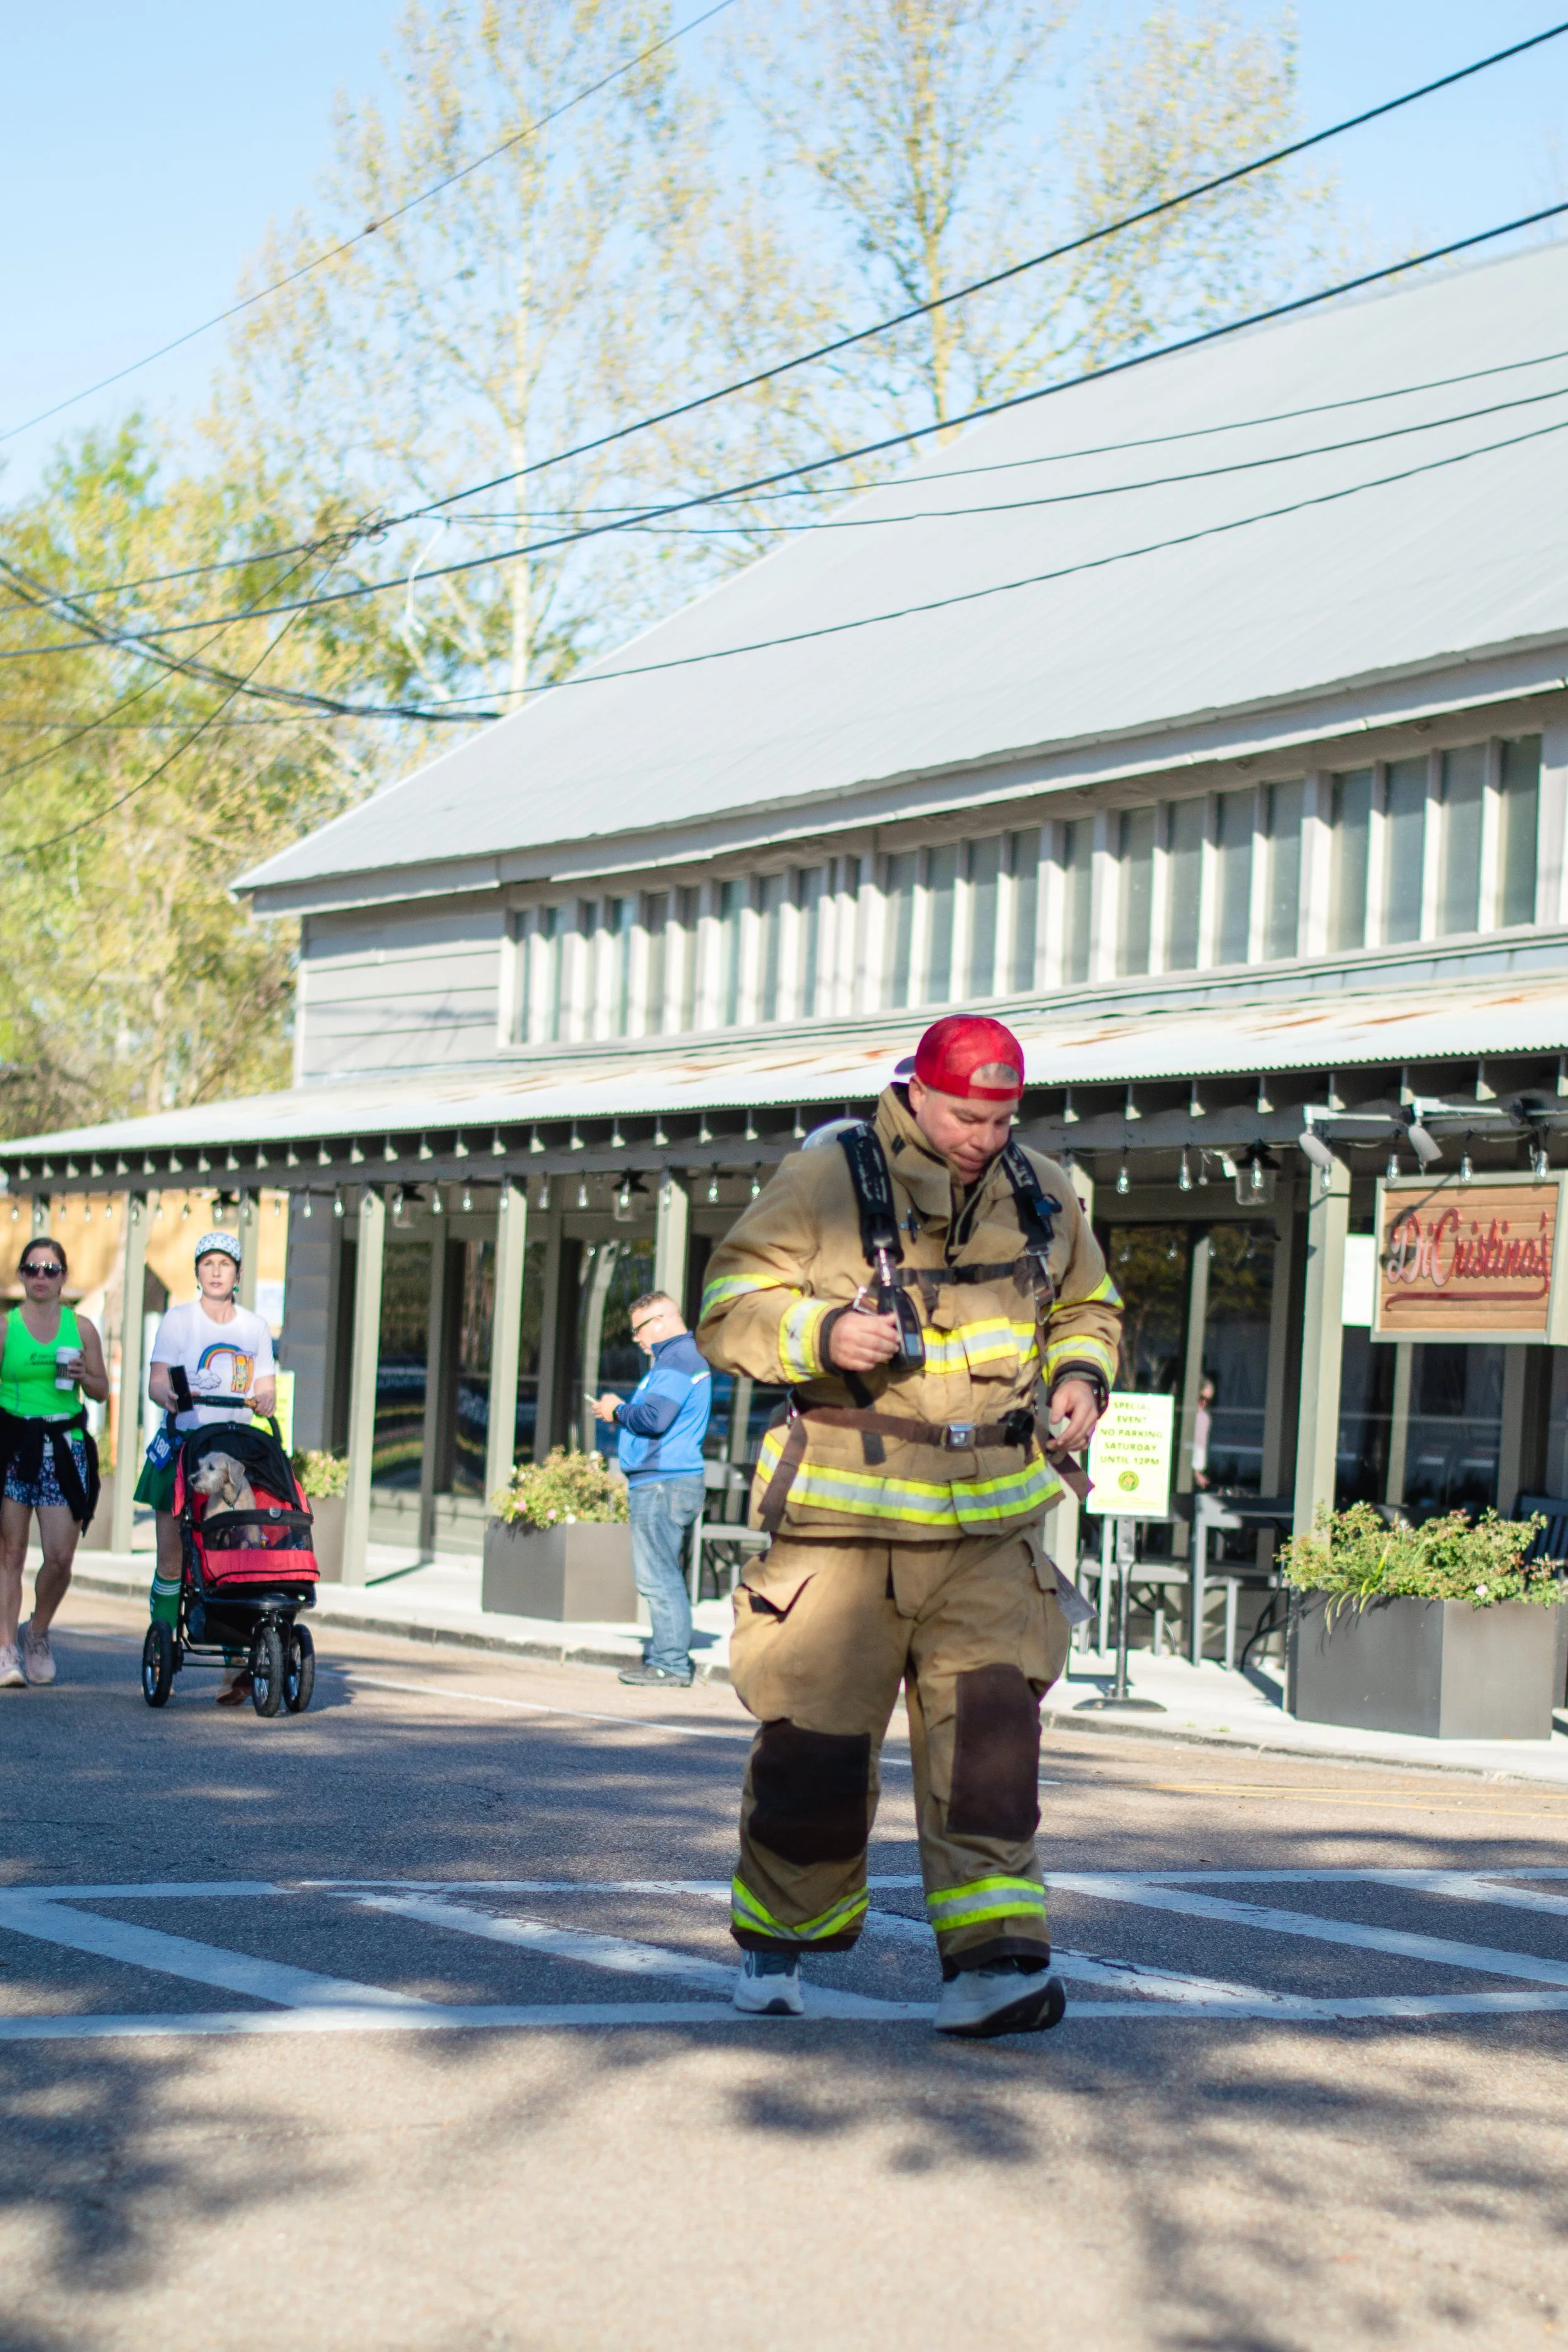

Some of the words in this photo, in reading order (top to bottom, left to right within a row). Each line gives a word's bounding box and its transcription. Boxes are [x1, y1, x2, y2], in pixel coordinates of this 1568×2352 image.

[1119, 1429, 1162, 1438] PARKING
[154, 1434, 171, 1458] 180
[1104, 1443, 1157, 1451] SATURDAY
[1100, 1456, 1129, 1464] UNTIL
